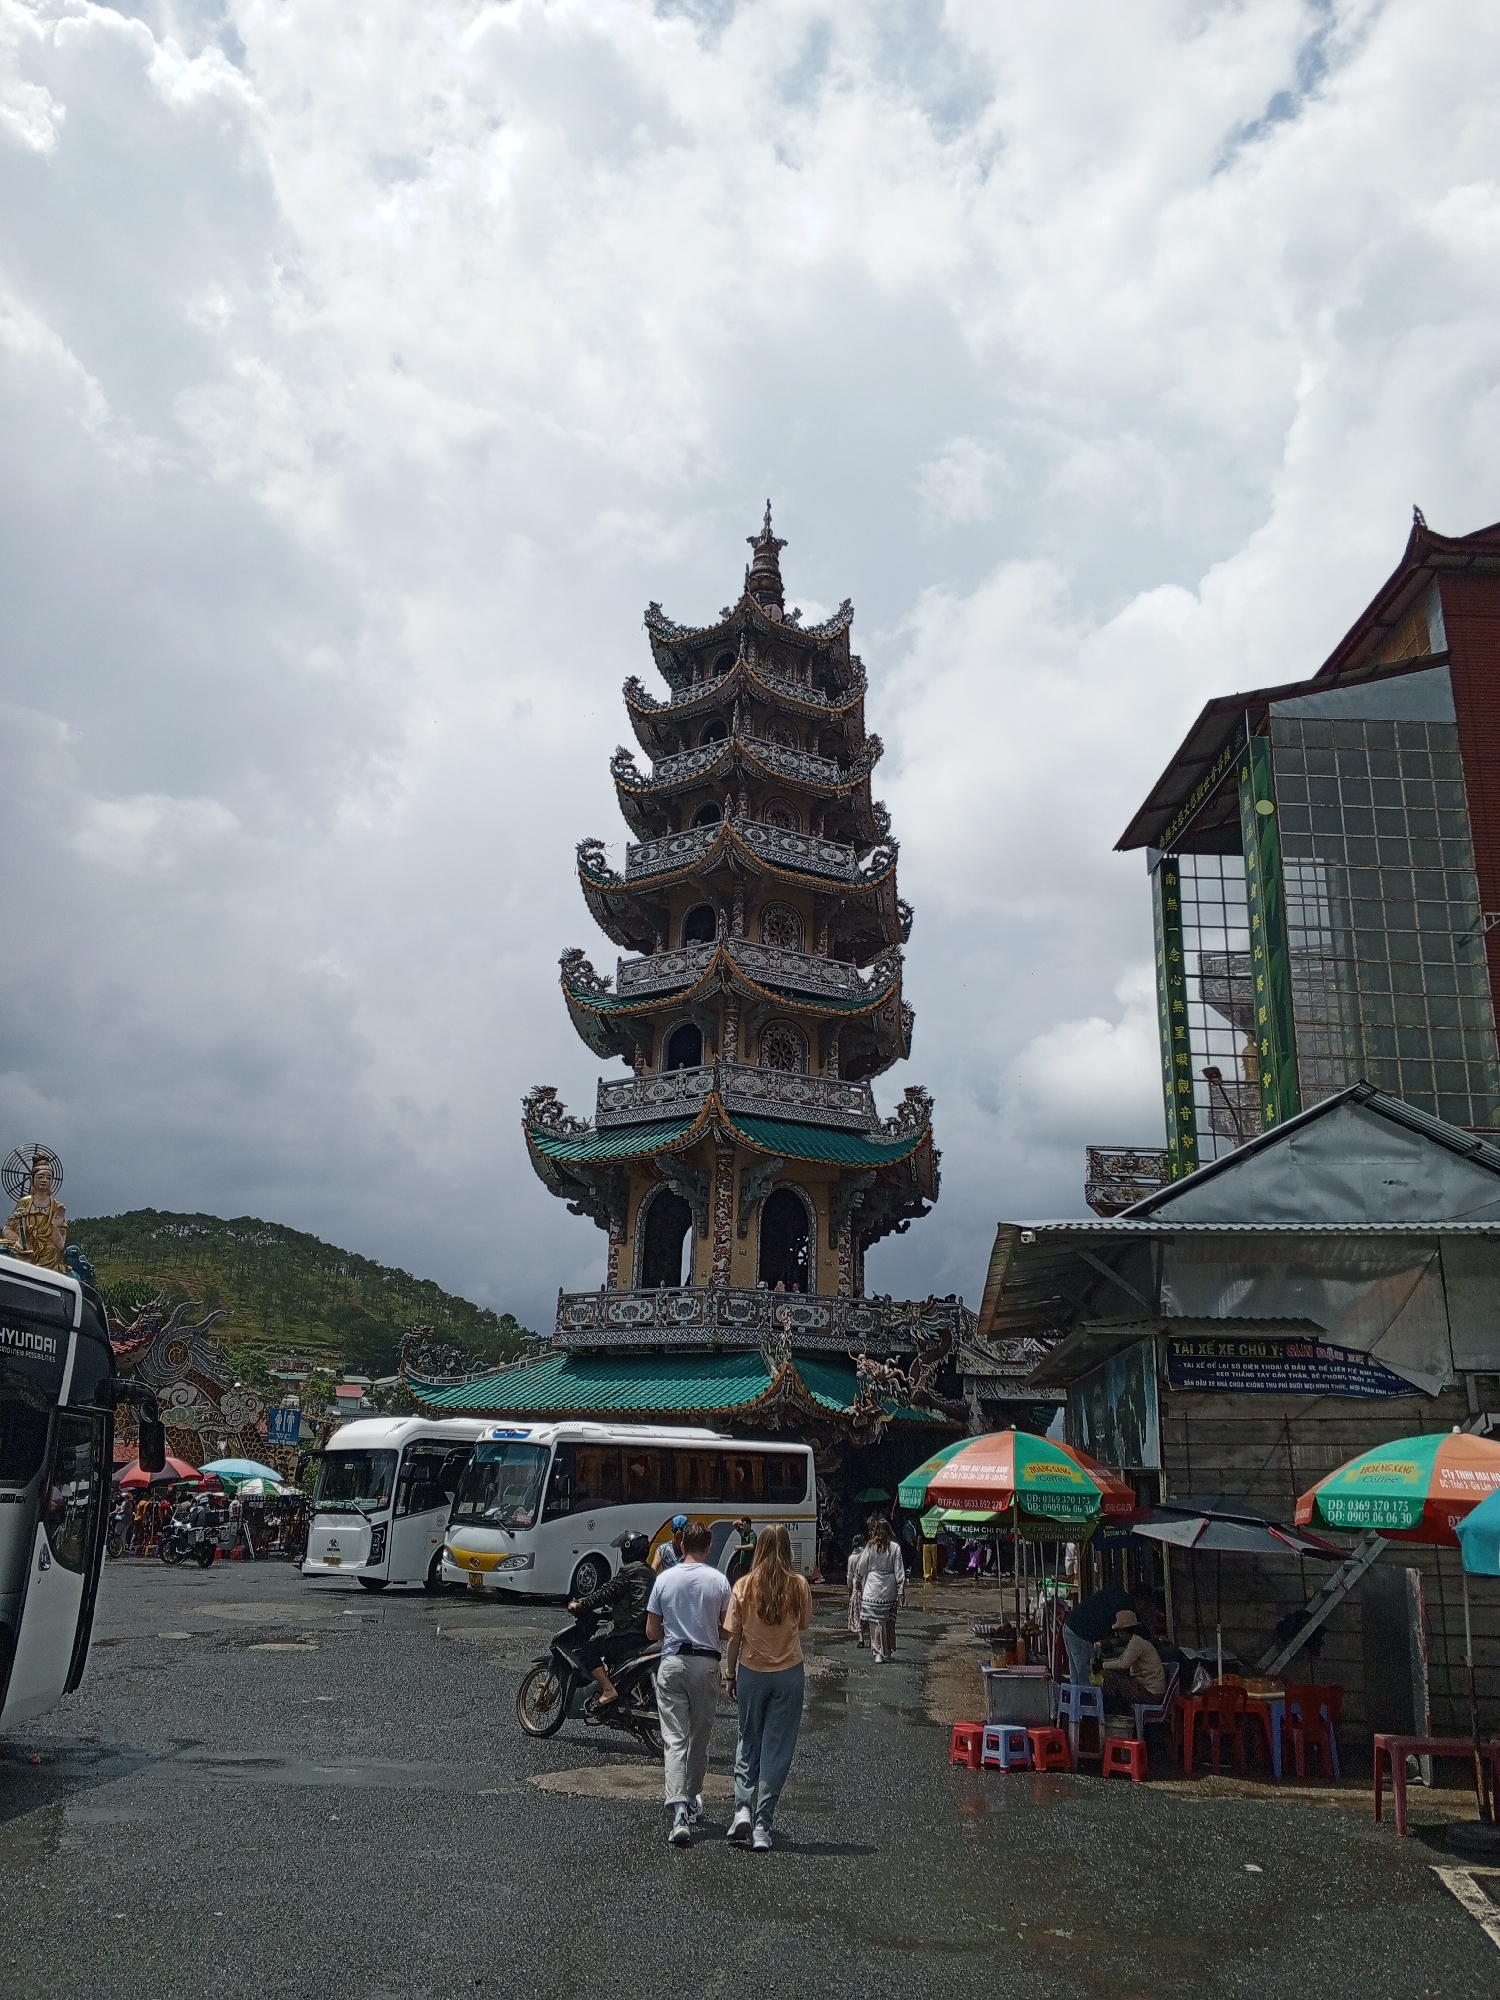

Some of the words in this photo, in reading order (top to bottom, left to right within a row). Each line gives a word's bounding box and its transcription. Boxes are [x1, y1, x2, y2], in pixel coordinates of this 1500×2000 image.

[0, 1327, 56, 1354] HYUNDAI
[1173, 1341, 1194, 1355] TÀI
[1218, 1343, 1235, 1355] XE
[276, 1432, 291, 1440] WC
[1039, 1475, 1068, 1483] Coffee
[1362, 1475, 1398, 1483] Coffee
[1061, 1495, 1075, 1504] 370
[1042, 1503, 1060, 1512] 0909
[1061, 1504, 1071, 1513] 06
[1073, 1504, 1082, 1513] 06
[1084, 1505, 1094, 1514] 30
[1347, 1500, 1370, 1511] 0369
[1372, 1500, 1389, 1511] 370
[1393, 1501, 1409, 1512] 175
[1347, 1511, 1370, 1522] 0909
[1372, 1511, 1384, 1523] 06
[1386, 1512, 1398, 1523] 06
[1400, 1512, 1412, 1524] 30
[962, 1524, 980, 1536] KIỆM
[981, 1526, 994, 1534] CHI
